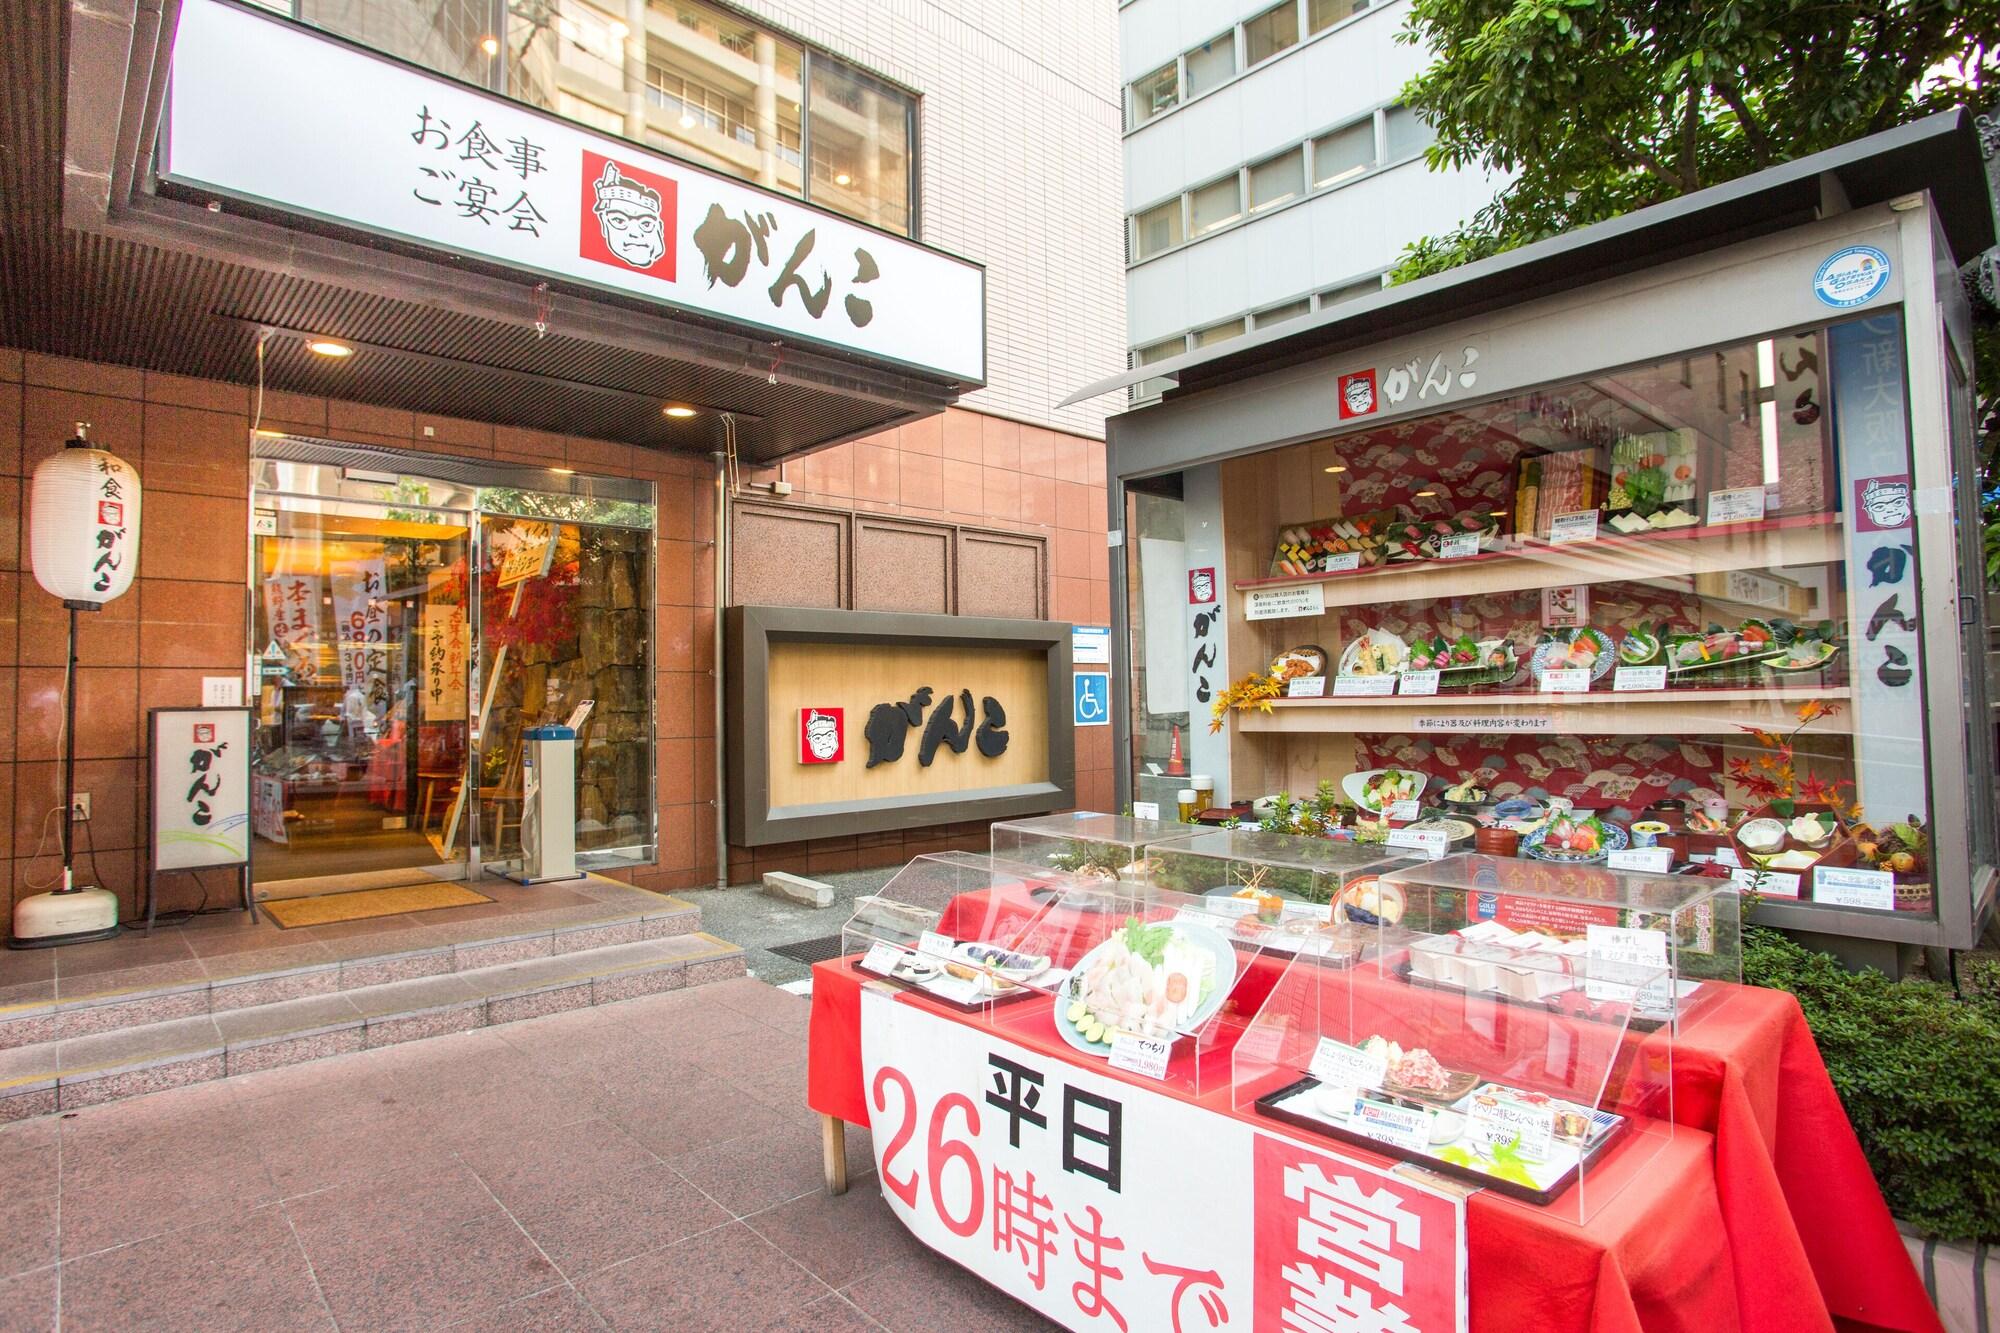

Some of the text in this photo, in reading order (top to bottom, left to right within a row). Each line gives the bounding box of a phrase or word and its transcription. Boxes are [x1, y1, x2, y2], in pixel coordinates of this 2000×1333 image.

[410, 104, 548, 181] お食事
[412, 165, 549, 239] ご宴会
[693, 202, 881, 328] がんこ
[1382, 346, 1479, 408] がんこ
[97, 458, 123, 500] 和食
[93, 527, 127, 592] がんこ
[429, 619, 446, 705] ご予約承り中
[1192, 605, 1221, 703] がんこ
[864, 686, 1009, 769] がんこ
[1419, 719, 1548, 729] 季節により器及び料理内容が変わります
[187, 742, 229, 826] がんこ
[1478, 902, 1495, 910] GOLD
[1507, 867, 1607, 901] 金賞受賞
[986, 1051, 1123, 1195] 平日
[872, 1066, 1231, 1333] 26時まで
